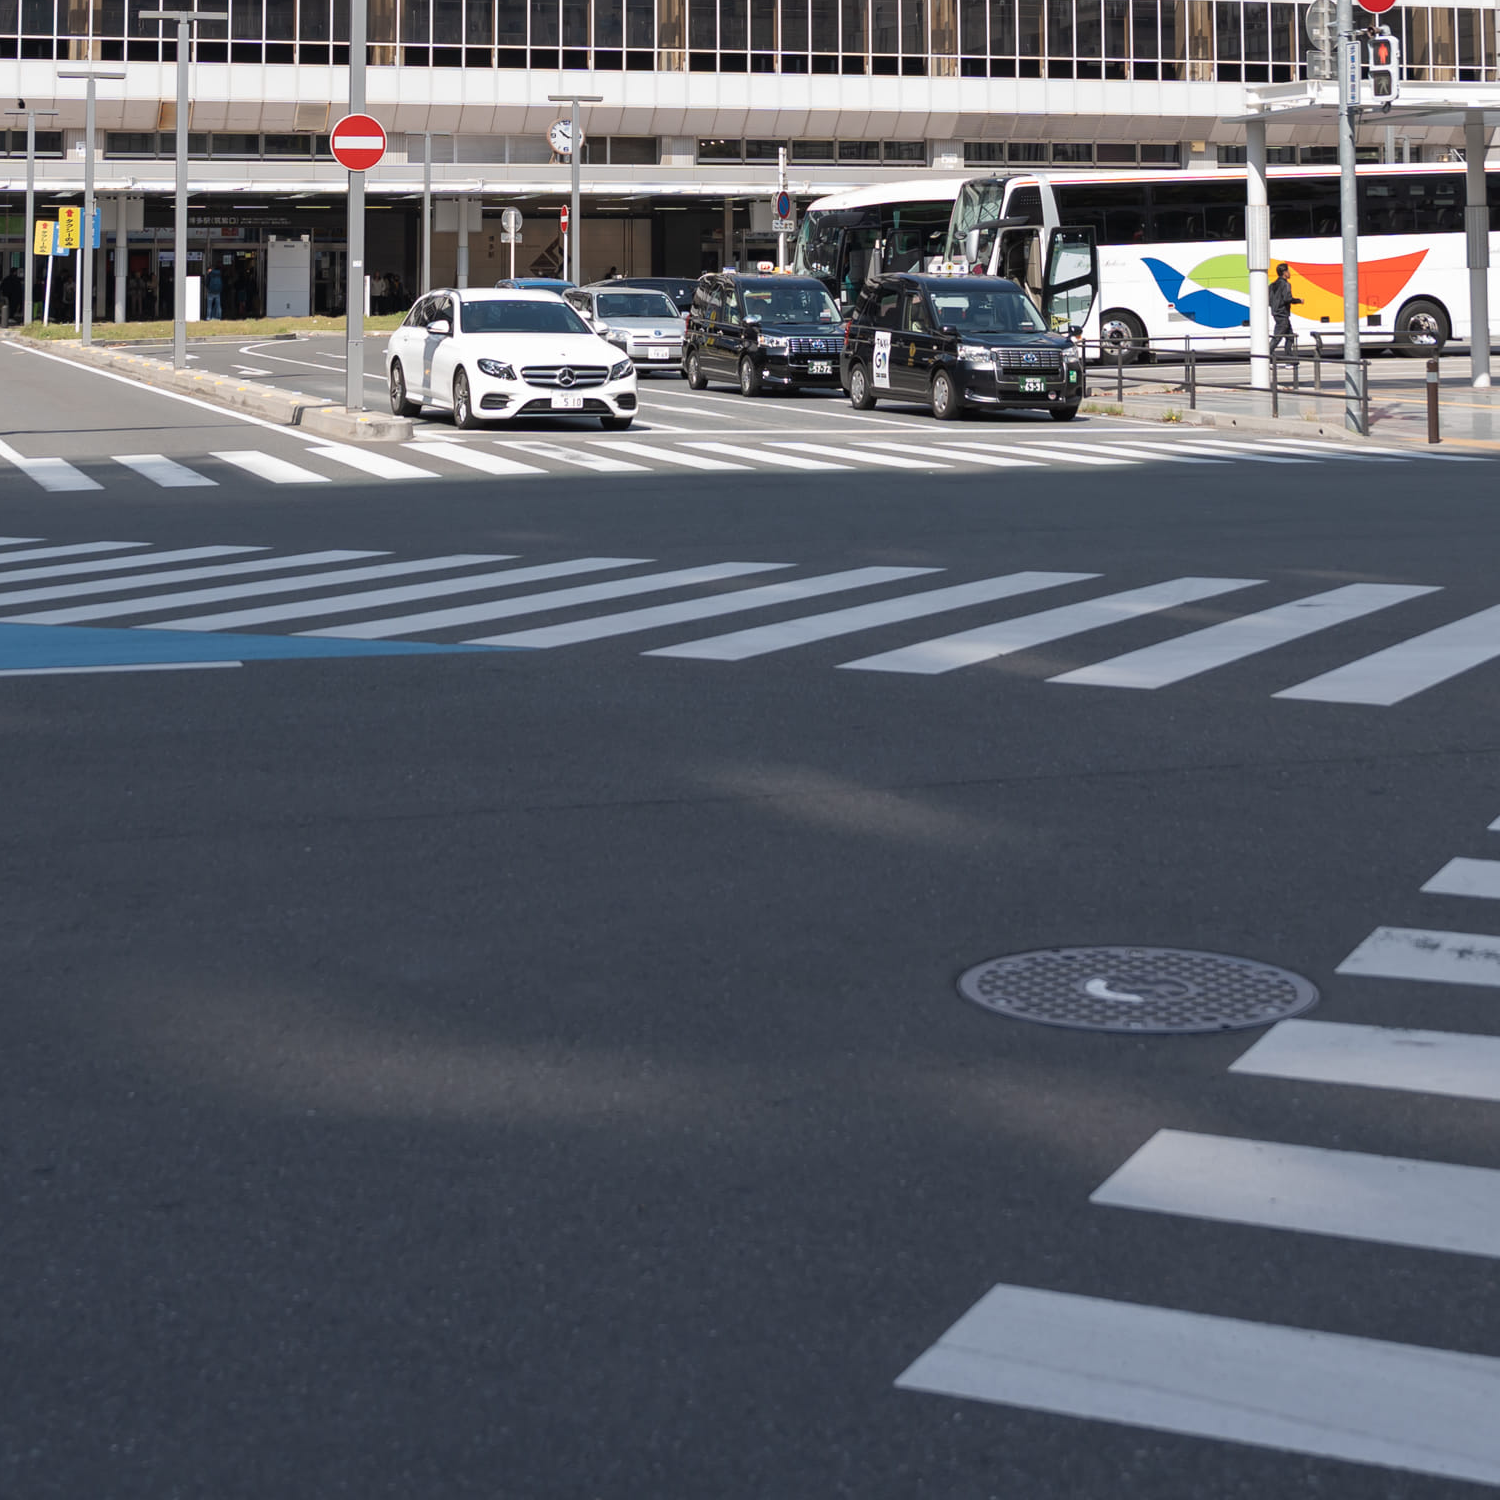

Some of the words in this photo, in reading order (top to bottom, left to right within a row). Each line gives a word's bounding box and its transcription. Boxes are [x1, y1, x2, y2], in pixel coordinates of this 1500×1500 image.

[64, 218, 74, 246] タクシーのみ
